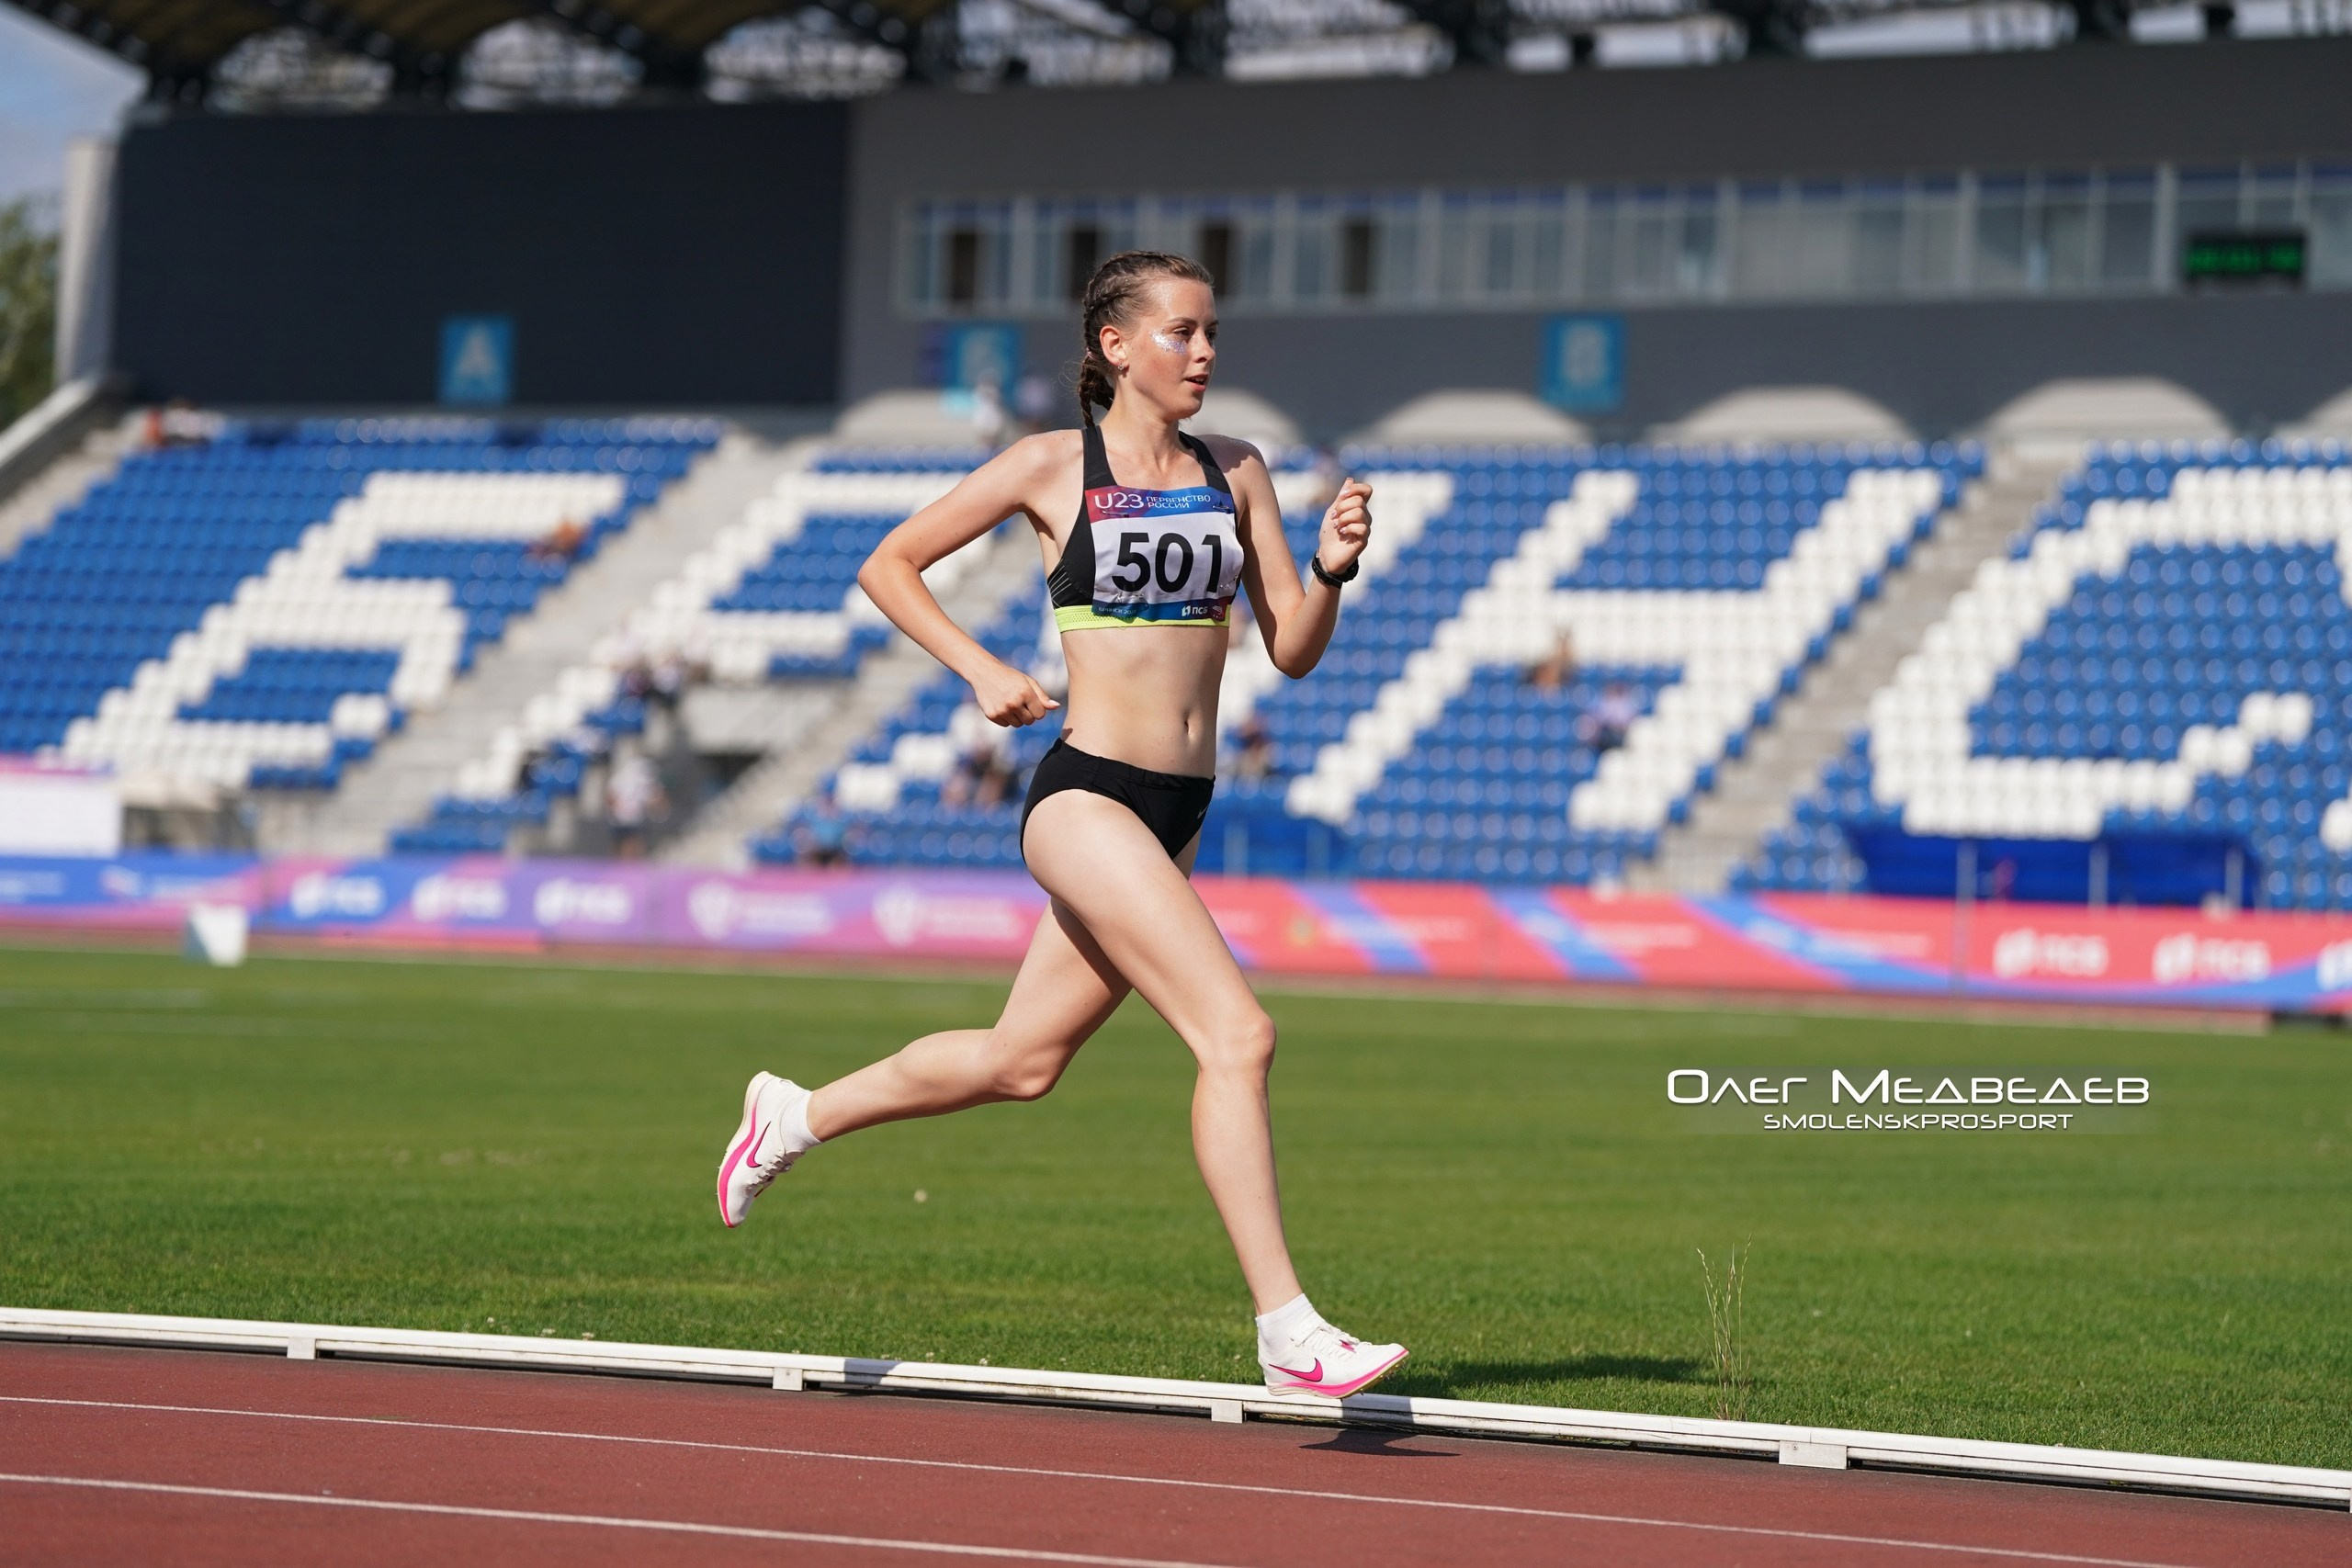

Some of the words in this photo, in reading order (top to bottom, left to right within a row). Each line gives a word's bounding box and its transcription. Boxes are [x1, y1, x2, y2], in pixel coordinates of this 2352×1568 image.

[1094, 491, 1144, 509] U23
[1146, 494, 1211, 502] ПЕРВЕНСТВО
[1112, 532, 1222, 593] 501
[1192, 606, 1208, 615] ПСБ
